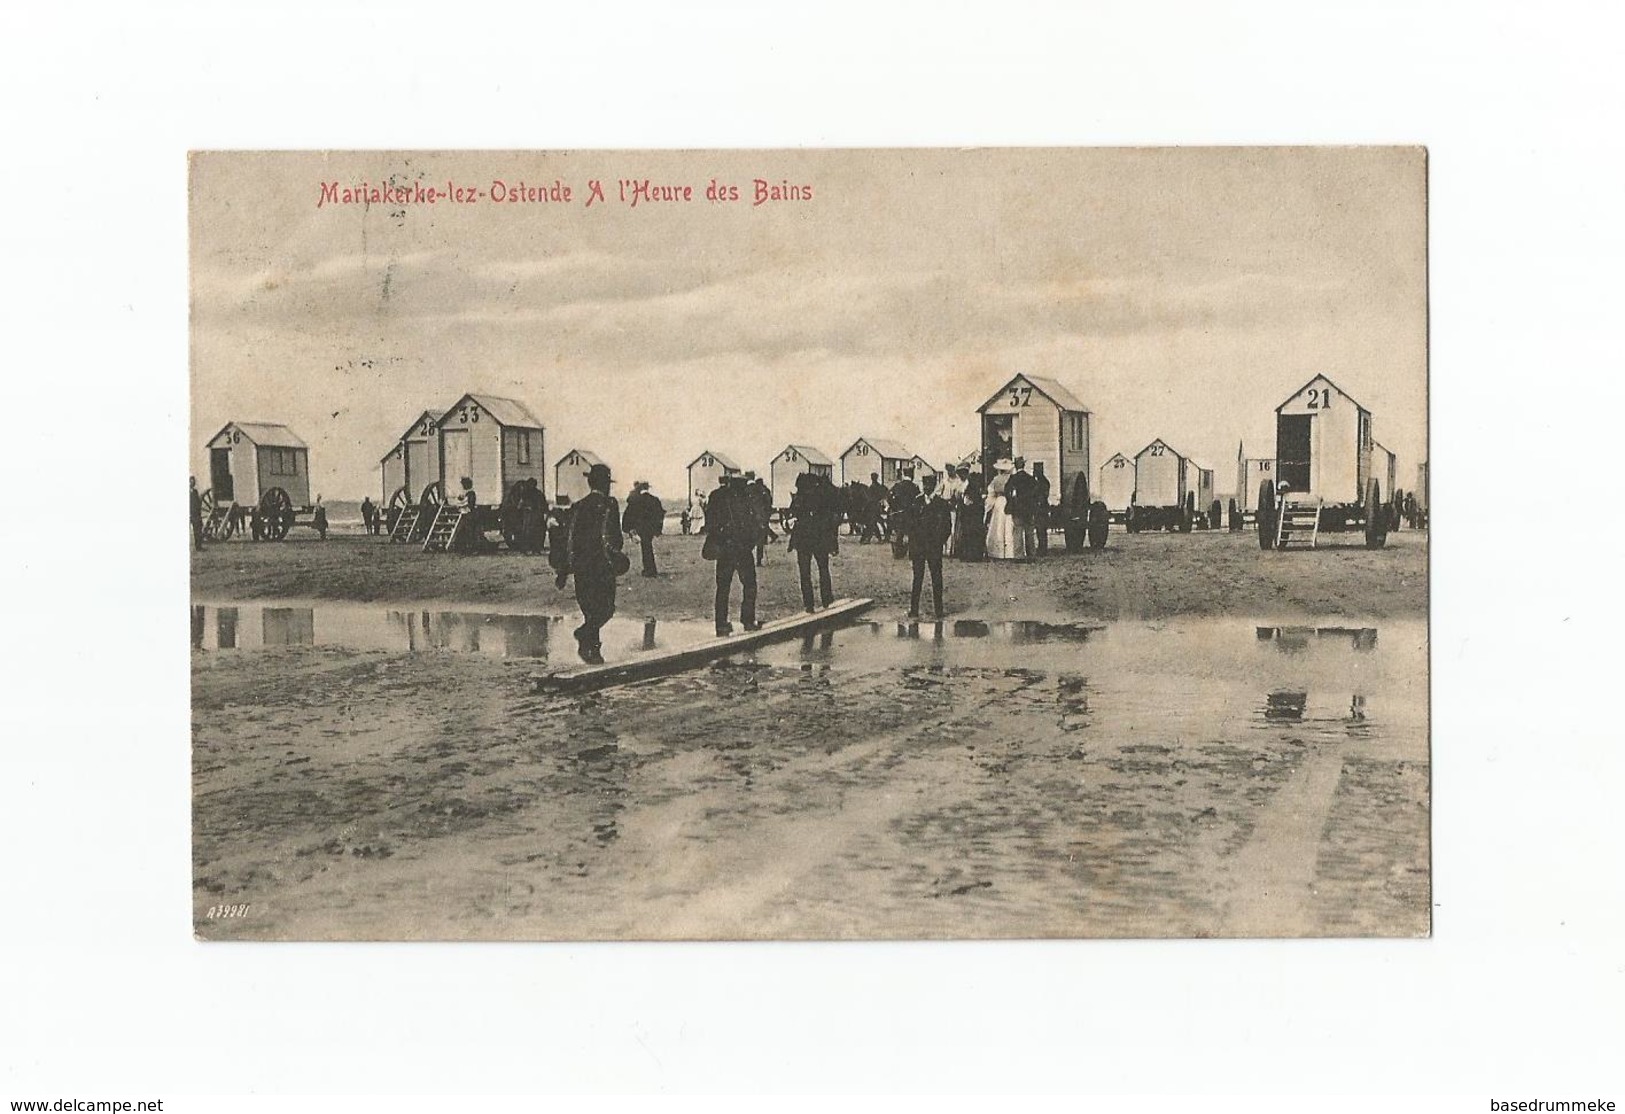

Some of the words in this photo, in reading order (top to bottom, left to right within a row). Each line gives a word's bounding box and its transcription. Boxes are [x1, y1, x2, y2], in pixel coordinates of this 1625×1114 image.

[1008, 387, 1033, 407] 37
[1307, 389, 1331, 409] 21
[459, 406, 479, 424] 33
[420, 421, 436, 436] 28
[1150, 446, 1165, 456] 27
[1258, 461, 1271, 472] 16
